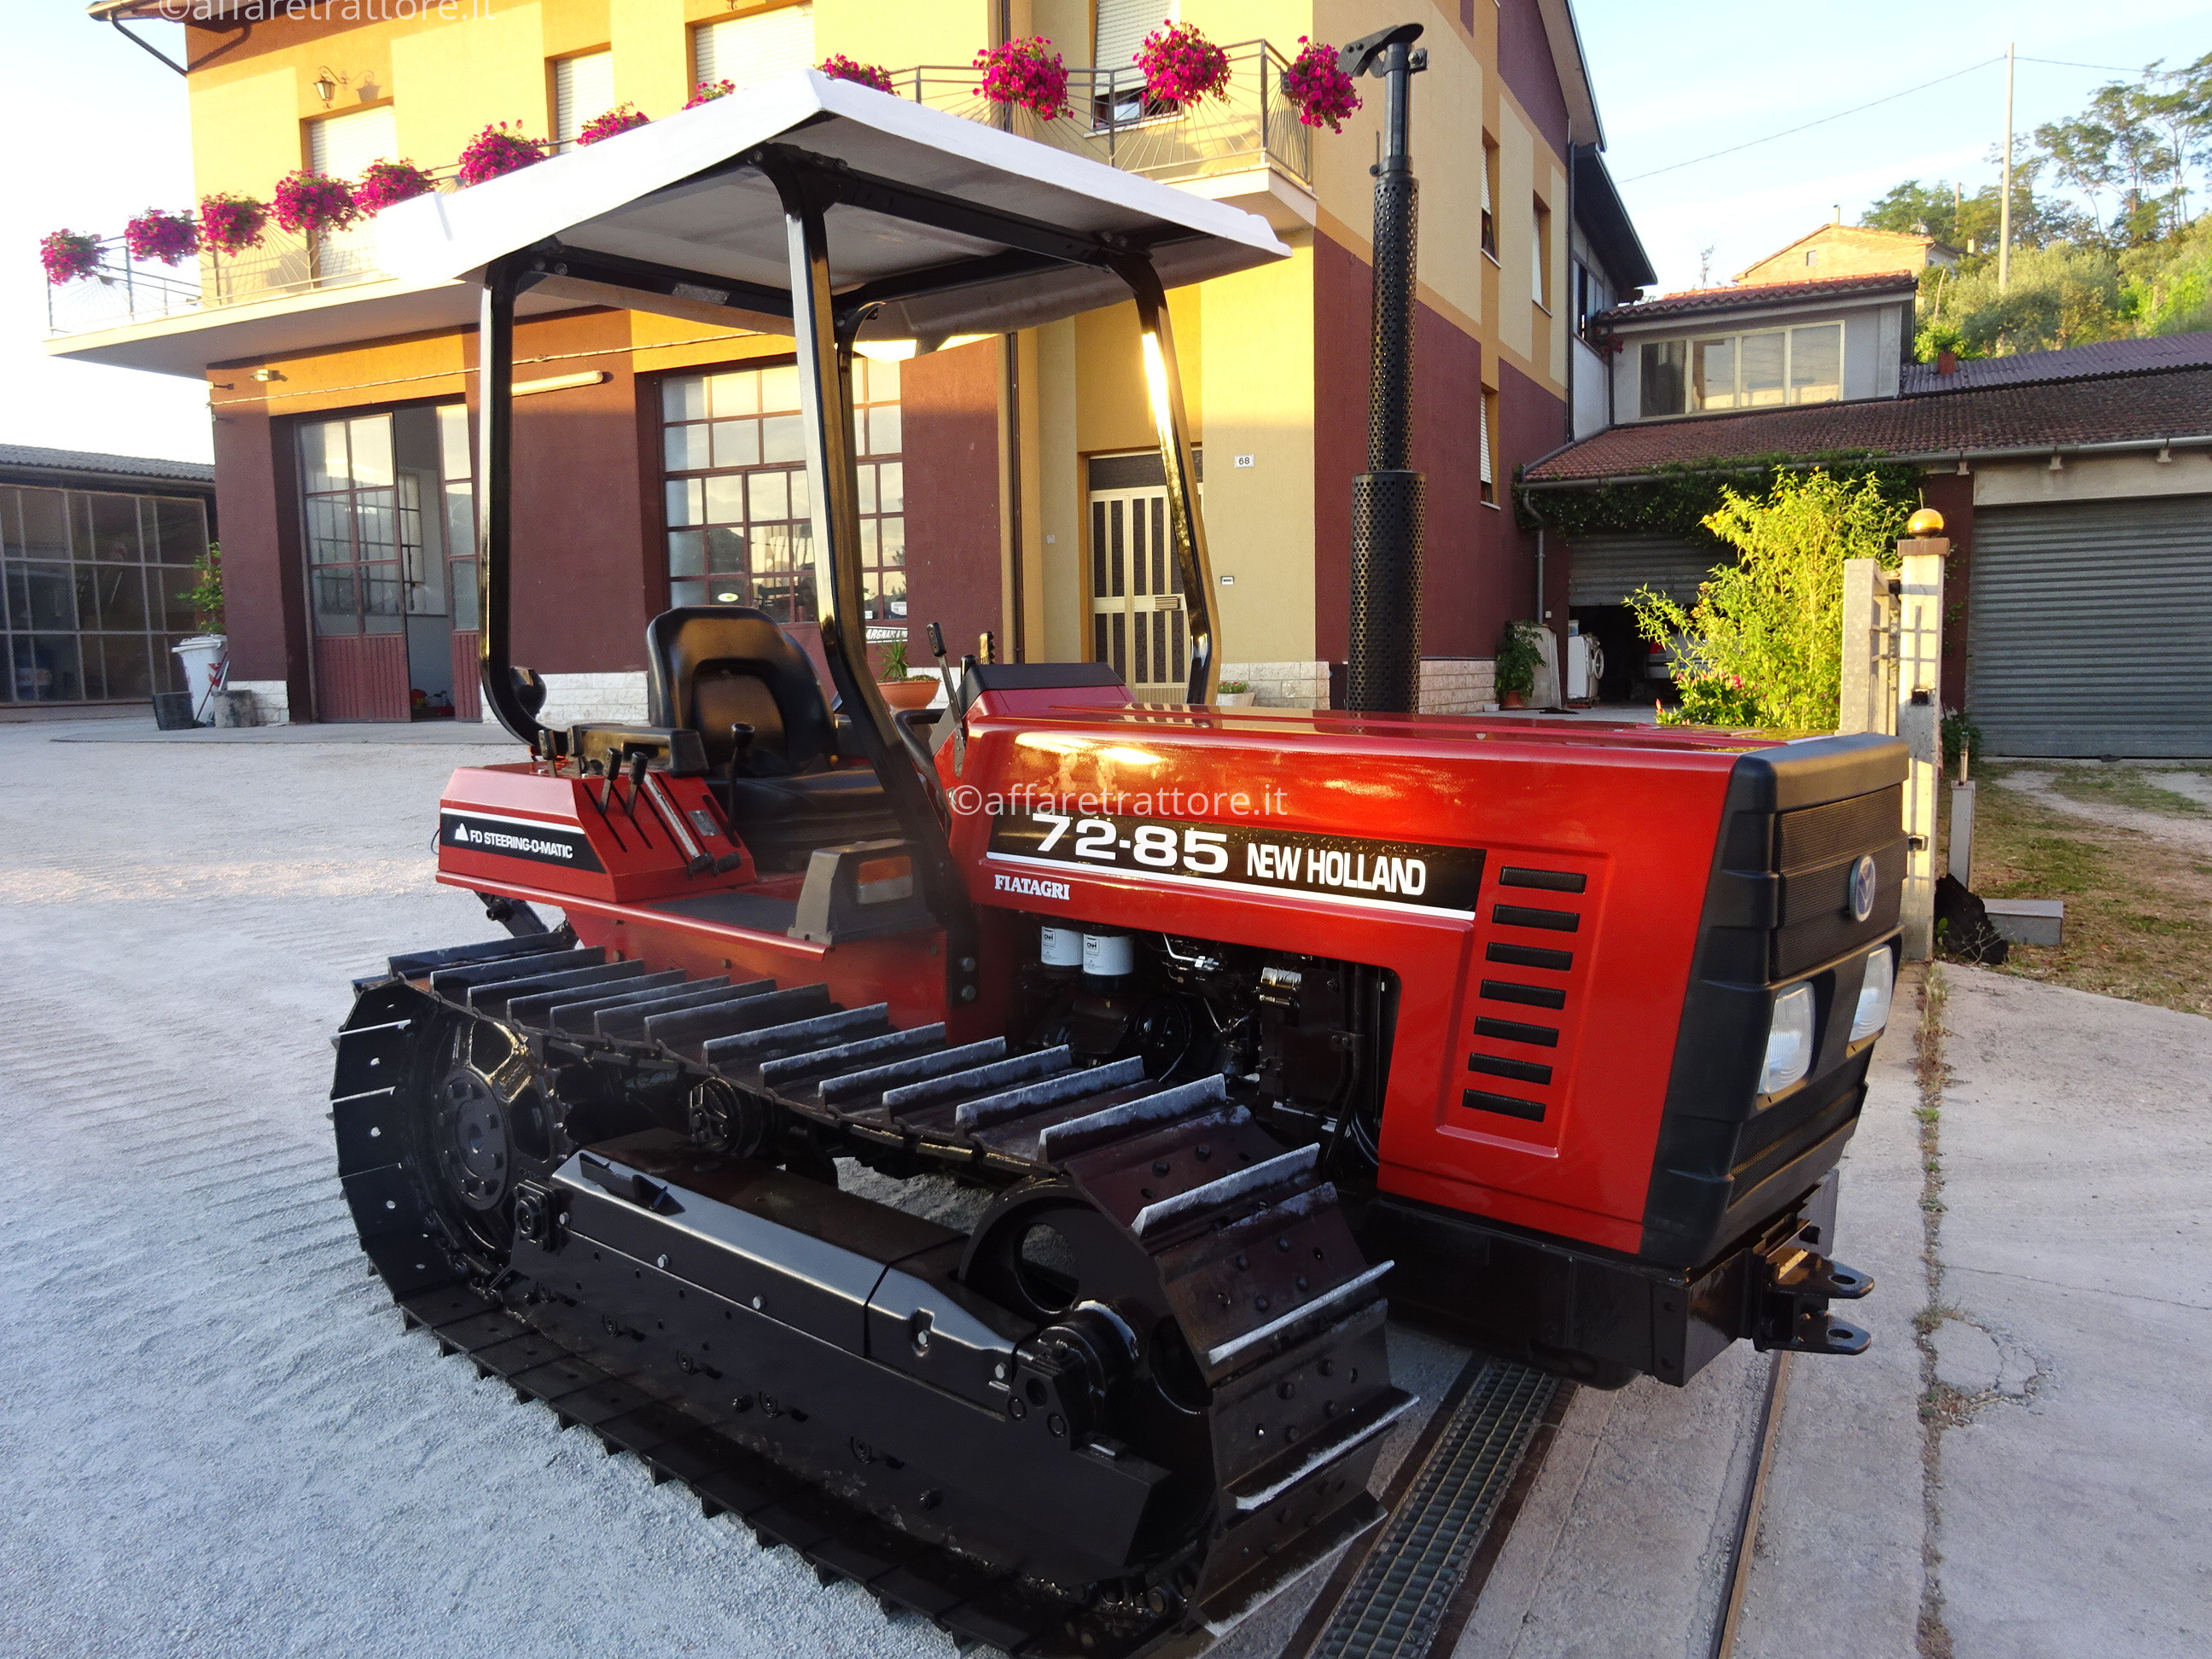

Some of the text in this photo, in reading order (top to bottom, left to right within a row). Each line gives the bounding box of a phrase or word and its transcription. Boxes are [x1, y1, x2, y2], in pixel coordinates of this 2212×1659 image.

[1238, 457, 1250, 465] 68
[470, 830, 573, 859] FD STEERING-O-MATIC
[1032, 812, 1427, 896] 72-85 NEW HOLLAND
[994, 874, 1070, 900] FIATAGRI
